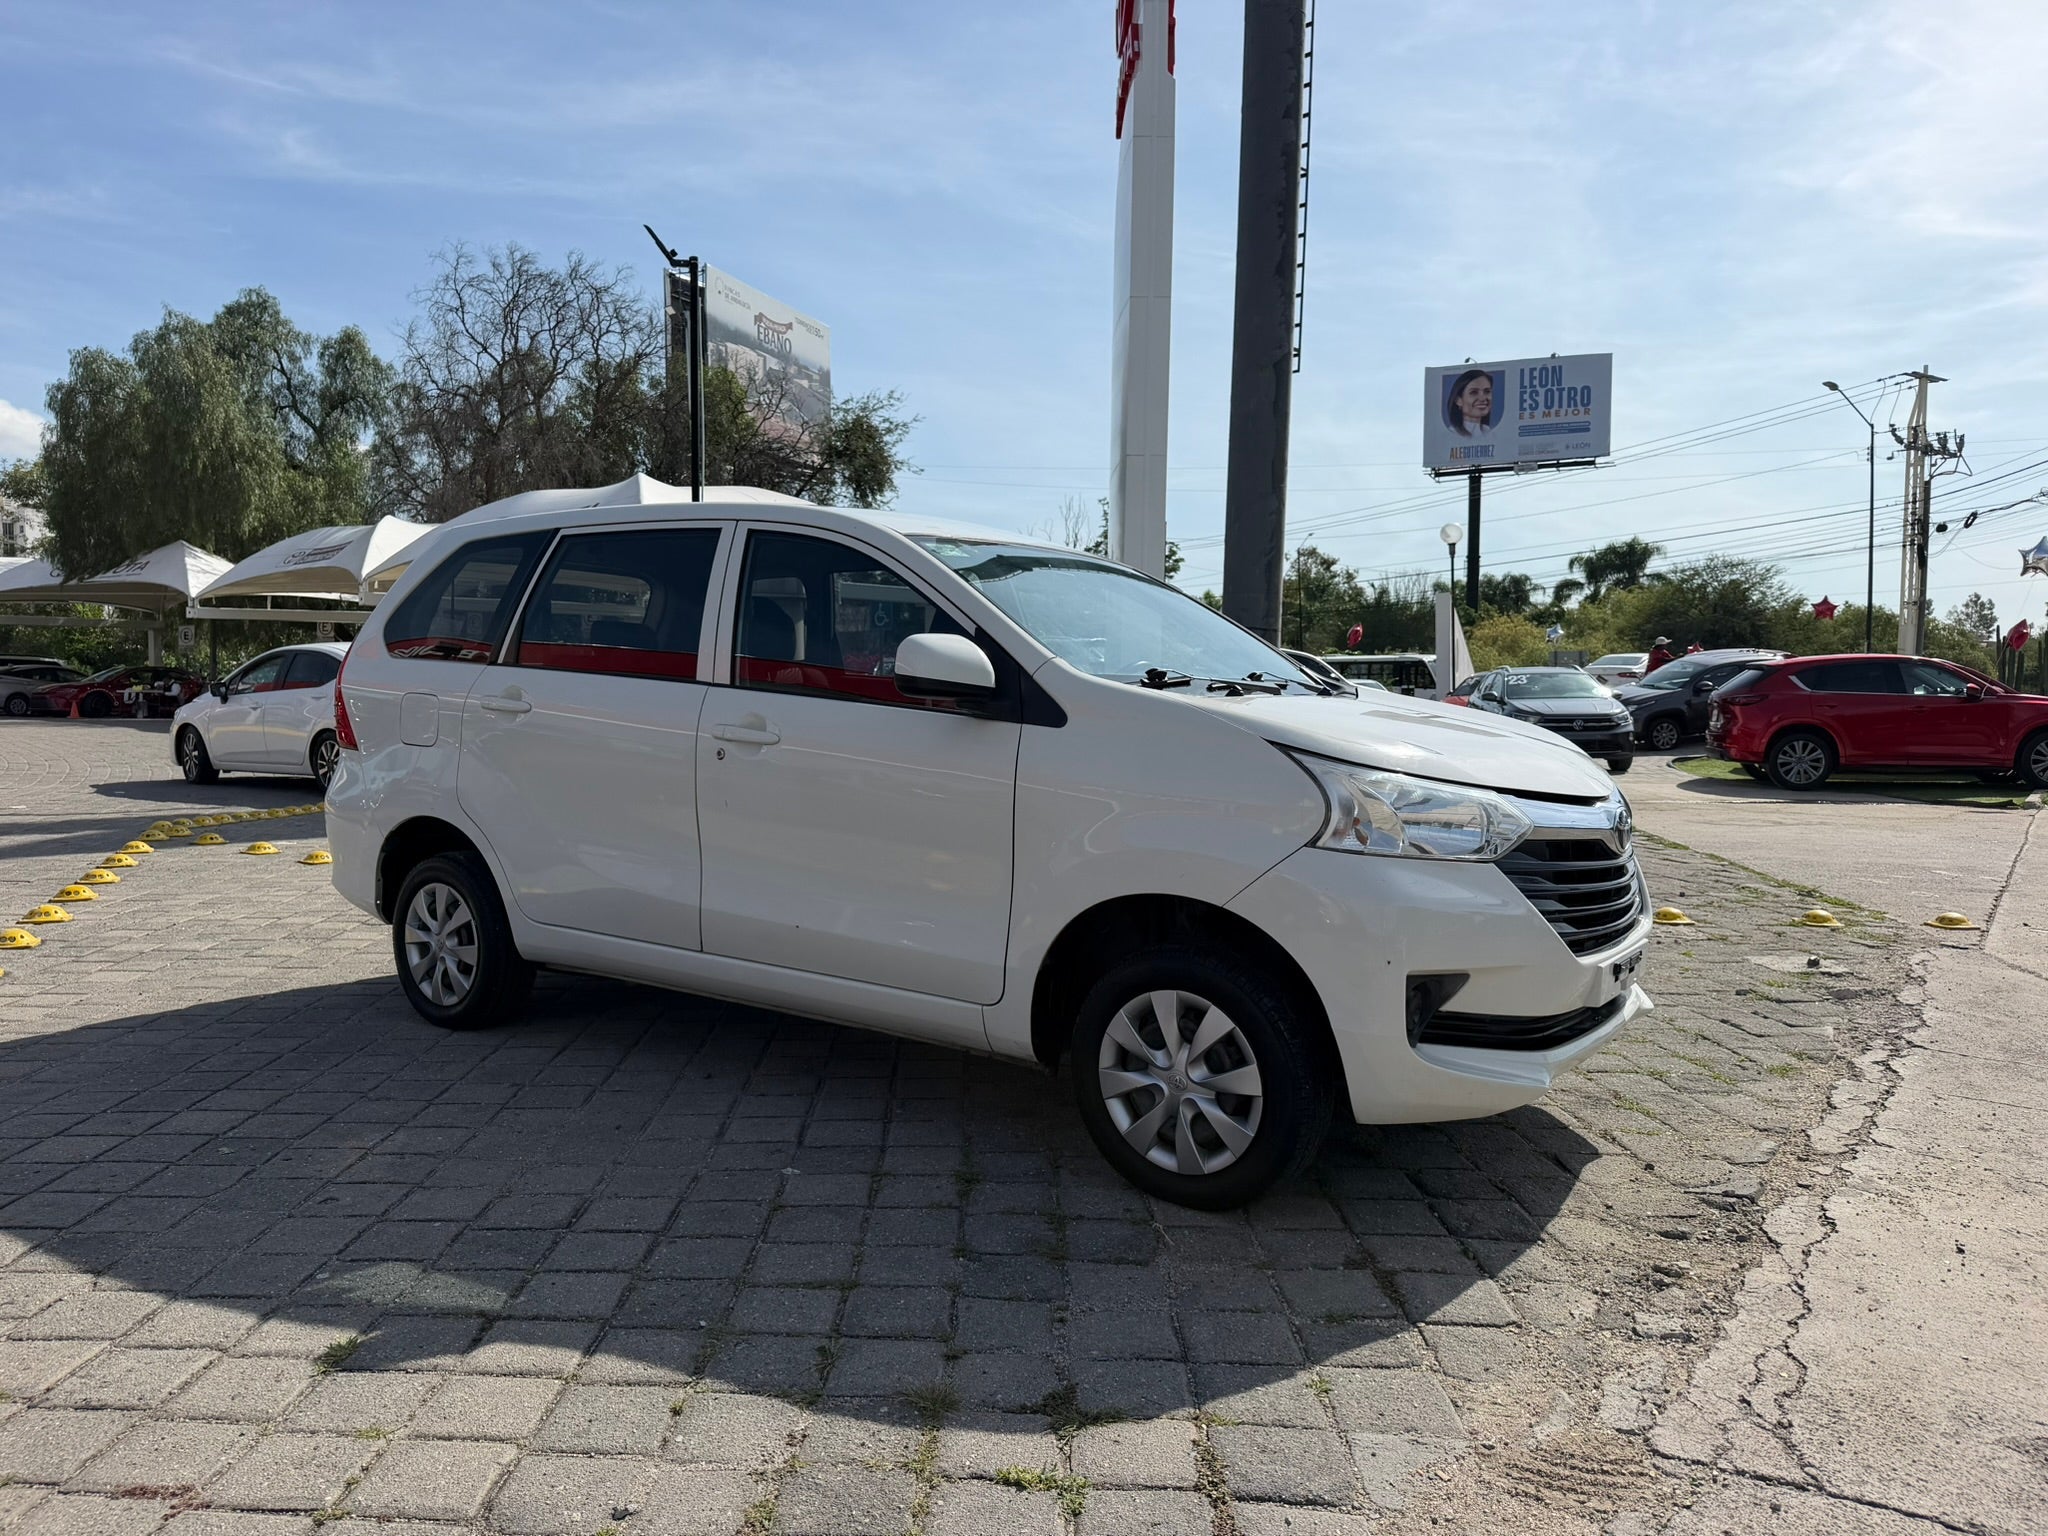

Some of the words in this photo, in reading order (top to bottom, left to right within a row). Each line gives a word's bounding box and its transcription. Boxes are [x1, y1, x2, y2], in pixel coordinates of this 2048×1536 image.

[1519, 364, 1563, 389] LEÓN
[1519, 389, 1540, 411] ES
[1543, 385, 1591, 410] OTRO
[1519, 411, 1536, 420] ES
[1542, 407, 1591, 419] MEJOR
